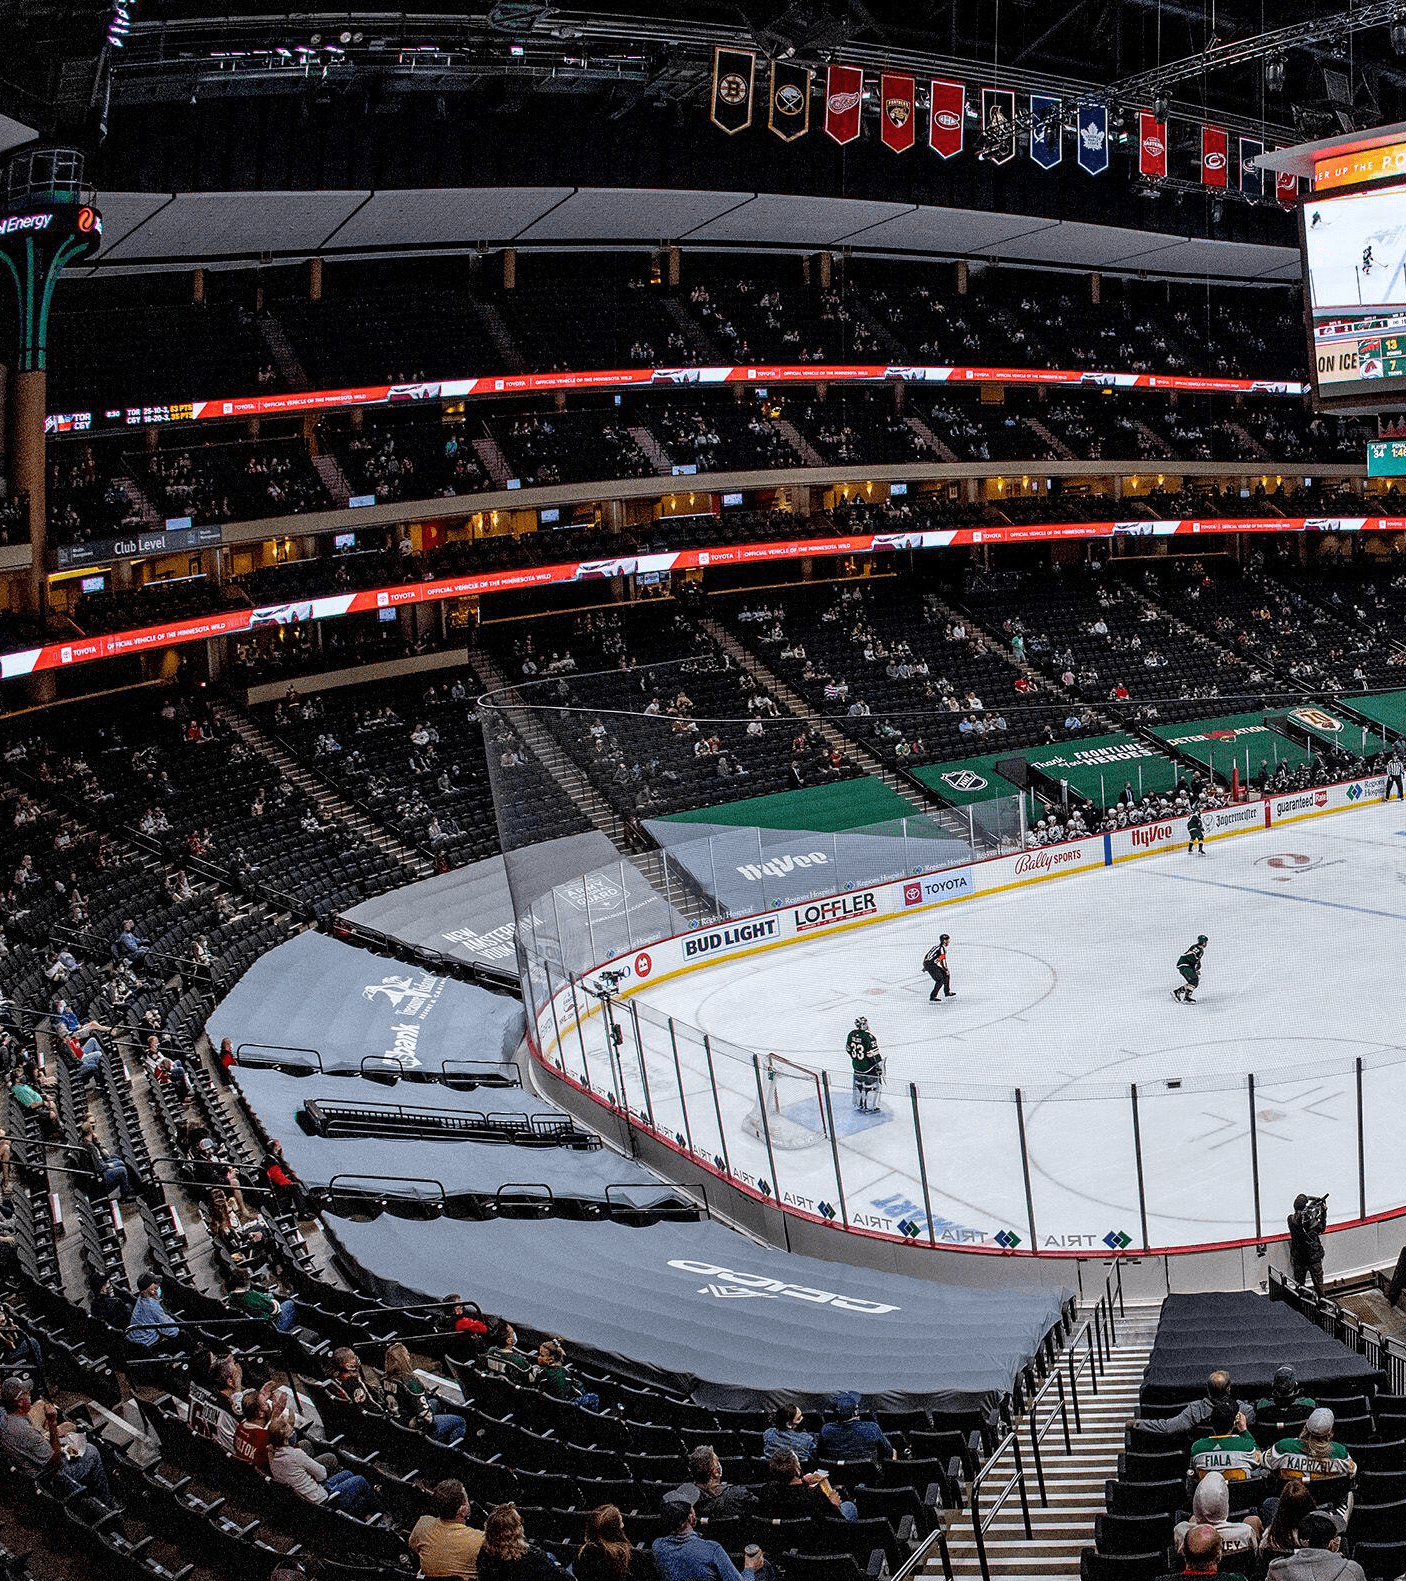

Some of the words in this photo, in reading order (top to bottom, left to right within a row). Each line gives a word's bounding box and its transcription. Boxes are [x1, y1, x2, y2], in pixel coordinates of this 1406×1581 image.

[1335, 167, 1348, 177] UP
[1354, 162, 1374, 173] THE
[1386, 339, 1397, 350] 13
[1318, 356, 1334, 373] ON
[1339, 352, 1358, 371] ICE
[1390, 359, 1396, 371] 7
[73, 412, 91, 422] TOR
[73, 421, 90, 430] CGY
[126, 416, 141, 424] CGY
[1373, 450, 1384, 458] 34
[114, 540, 137, 555] Club
[138, 536, 165, 551] Level
[427, 587, 453, 595] OFFICIAL
[454, 583, 478, 591] VEHICLE
[501, 575, 535, 585] MINNESOTA
[390, 592, 415, 600] TOYOTA
[107, 640, 133, 651] OFFICIAL
[134, 636, 157, 646] VEHICLE
[177, 625, 210, 637] MINNESOTA
[211, 623, 226, 631] WILD
[73, 646, 96, 656] TOYOTA
[1074, 743, 1144, 760] FRONTLINE
[1082, 749, 1154, 765] HEROES
[1031, 756, 1066, 770] Thank
[1276, 793, 1314, 816] guaranteed
[1131, 825, 1173, 847] HyVee
[735, 852, 828, 881] HyVee
[1015, 851, 1054, 875] Bally
[1053, 849, 1081, 865] SPORTS
[880, 870, 905, 884] Hospital
[785, 894, 809, 904] Regions
[810, 885, 836, 898] Hospital
[925, 877, 967, 895] TOYOTA
[794, 892, 876, 926] LOFFLER
[685, 934, 721, 956] BUD
[724, 919, 776, 946] LIGHT
[390, 1023, 420, 1055] bank
[850, 1042, 865, 1060] 33
[667, 1260, 901, 1314] GEICO
[1205, 1454, 1232, 1467] FIALA
[1287, 1459, 1335, 1471] KAPRIZOV
